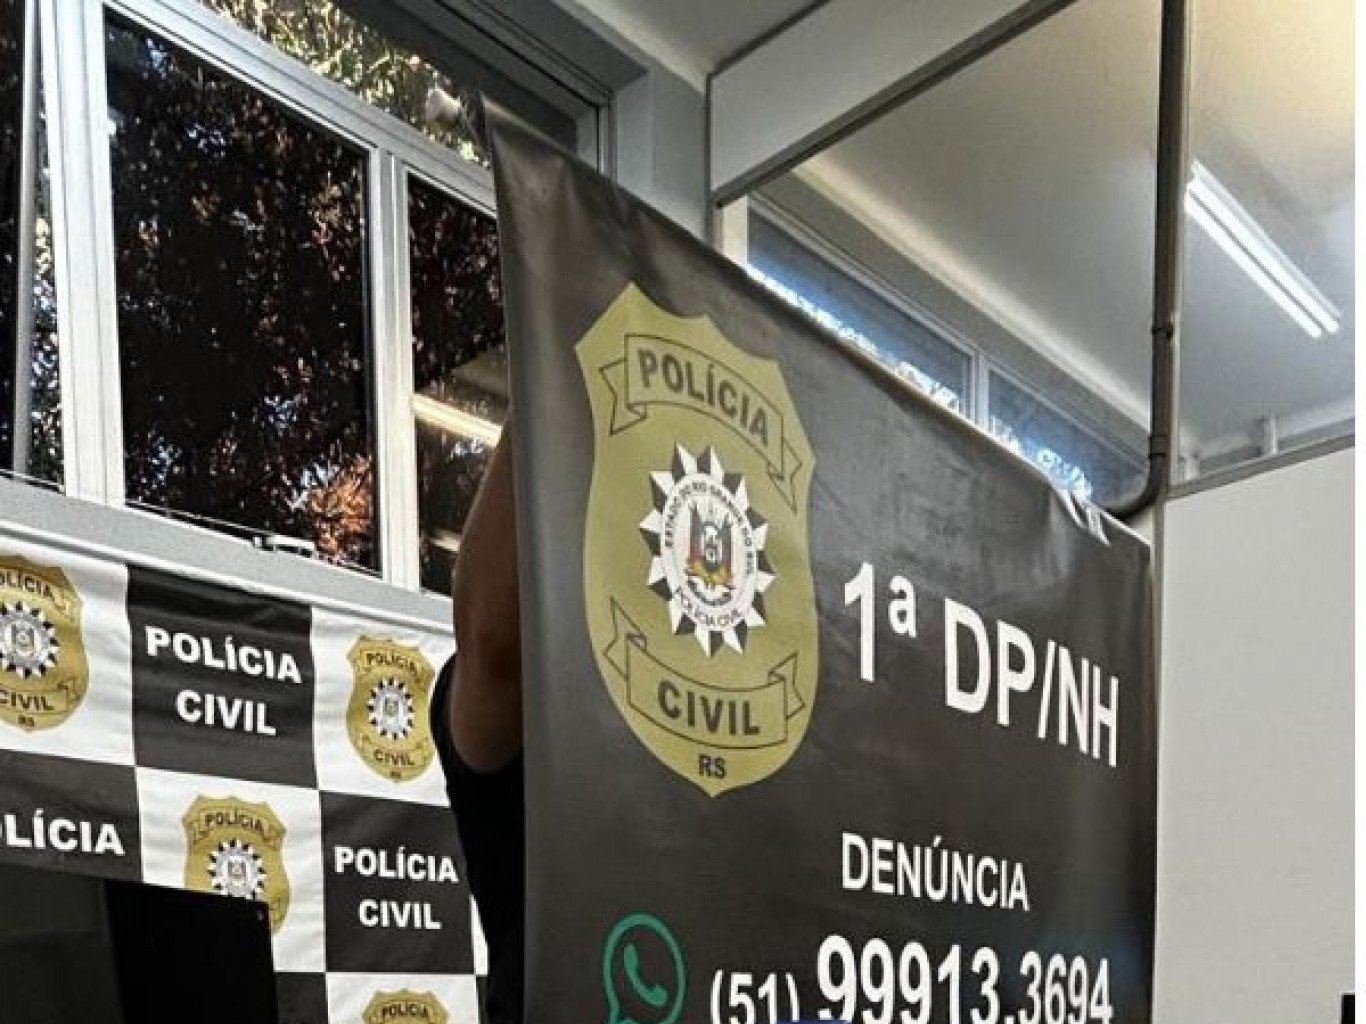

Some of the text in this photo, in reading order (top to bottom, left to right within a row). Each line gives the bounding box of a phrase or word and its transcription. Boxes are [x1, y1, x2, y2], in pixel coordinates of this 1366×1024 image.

[637, 347, 769, 445] POLÍCIA
[145, 625, 302, 684] POLÍCIA
[943, 596, 1118, 768] DP/NH
[175, 690, 277, 736] CIVIL
[657, 682, 760, 737] CIVIL
[698, 753, 728, 780] RS
[0, 807, 126, 857] LÍCIA
[334, 846, 459, 884] POLÍCIA
[842, 832, 1030, 911] DENÚNCIA
[358, 899, 441, 930] CIVIL
